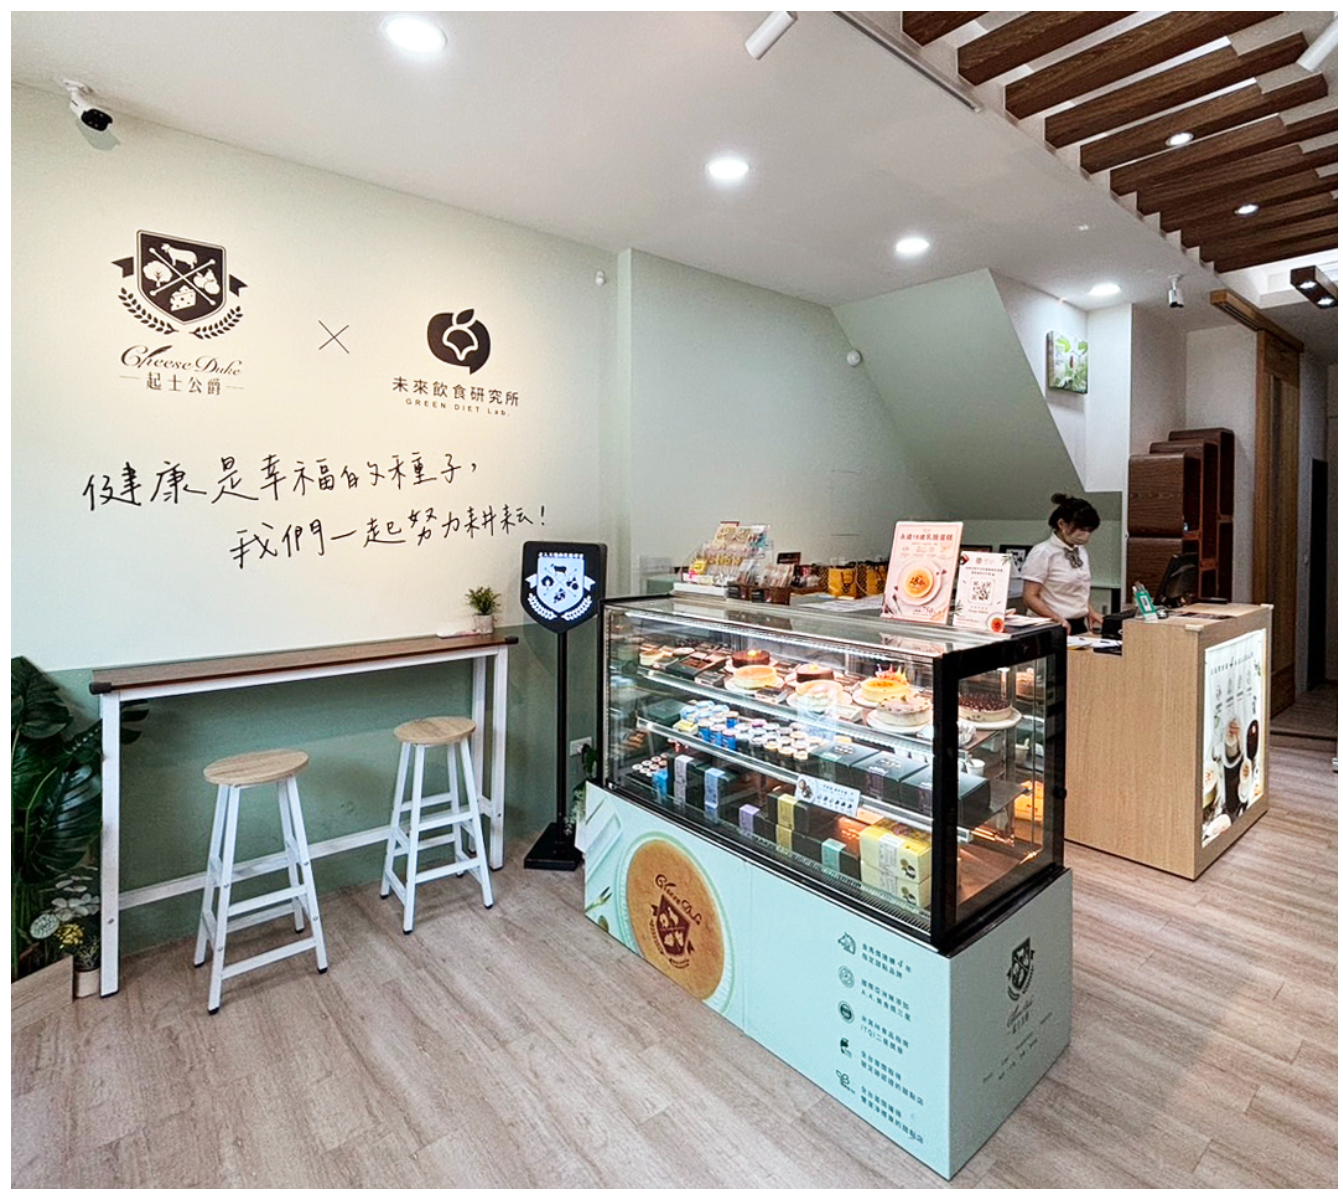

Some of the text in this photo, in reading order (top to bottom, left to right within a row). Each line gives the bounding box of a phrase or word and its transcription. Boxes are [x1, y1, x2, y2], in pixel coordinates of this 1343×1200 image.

[120, 344, 243, 376] Cheese Duke
[146, 371, 221, 396] 起士公爵
[392, 375, 519, 407] 未來飲食研究所
[405, 398, 446, 410] GREEN
[454, 404, 480, 413] DIET
